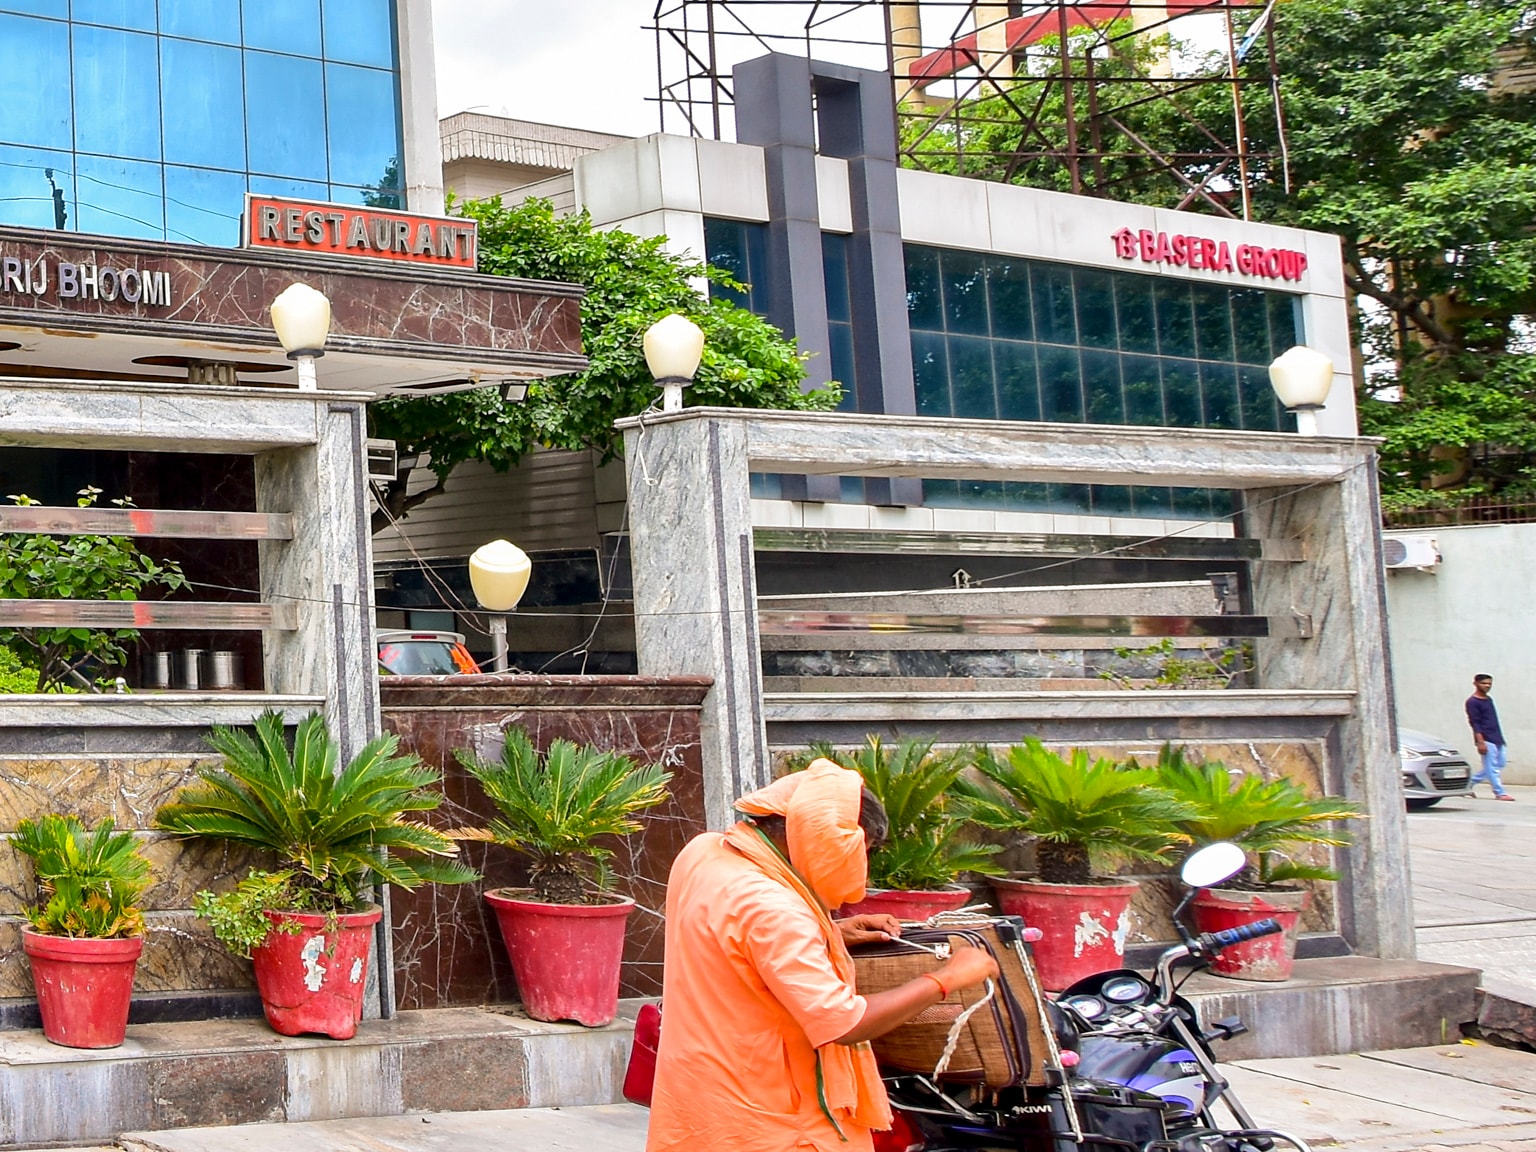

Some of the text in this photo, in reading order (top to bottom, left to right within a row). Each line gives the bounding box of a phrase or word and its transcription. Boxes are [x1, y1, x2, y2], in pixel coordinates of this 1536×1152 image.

[258, 205, 474, 260] RESTAURANT
[1139, 229, 1234, 273] BASERA
[1236, 244, 1308, 282] GROUP
[59, 262, 171, 307] BHOOMI
[1020, 1104, 1053, 1114] KIWI
